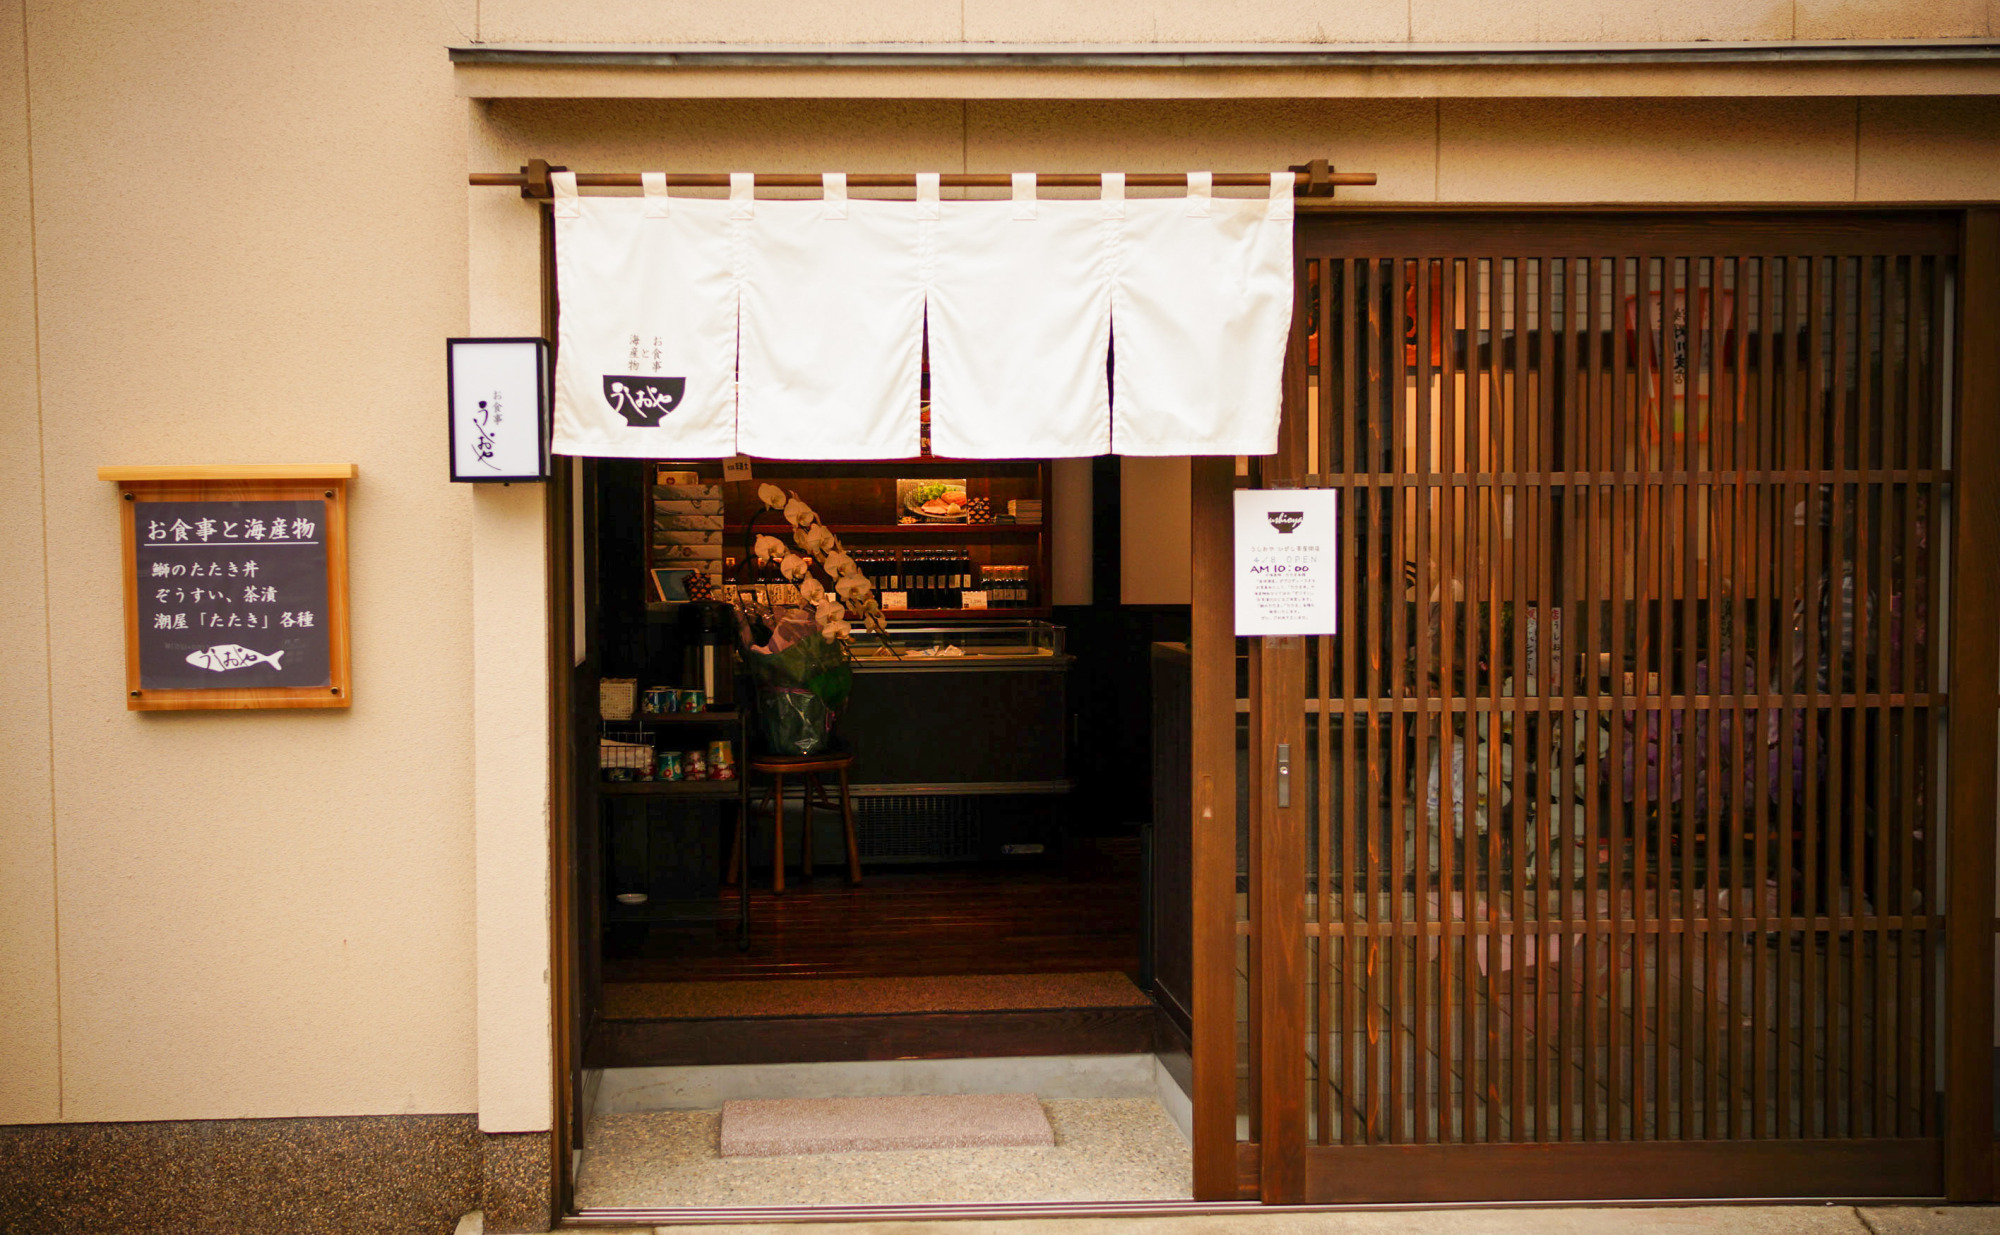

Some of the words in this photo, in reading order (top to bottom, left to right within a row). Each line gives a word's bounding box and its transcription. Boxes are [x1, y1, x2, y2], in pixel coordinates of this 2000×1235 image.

[628, 334, 640, 371] 海産物
[642, 349, 649, 359] と
[652, 336, 663, 373] お食事
[493, 390, 503, 425] お食事
[147, 517, 316, 542] お食事と海産物
[152, 560, 259, 578] 鰤のたたき丼
[1250, 565, 1269, 574] AM
[153, 611, 315, 630] 潮屋「たたき」各種
